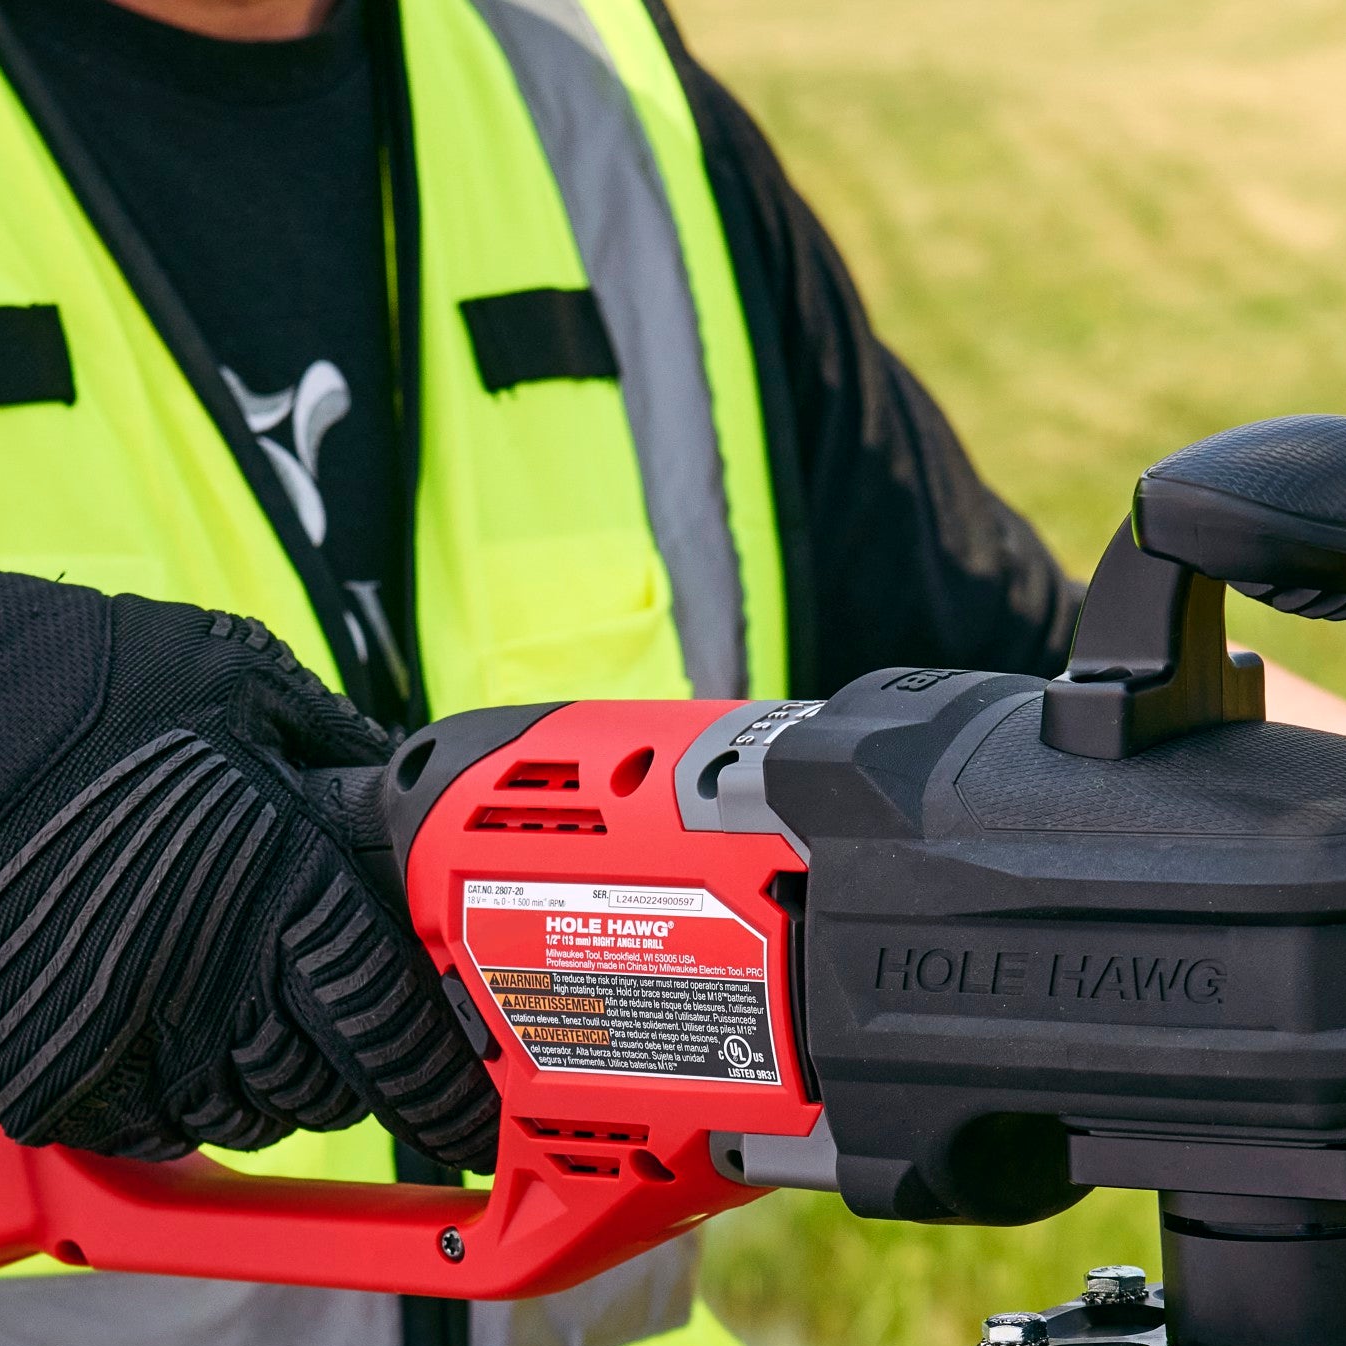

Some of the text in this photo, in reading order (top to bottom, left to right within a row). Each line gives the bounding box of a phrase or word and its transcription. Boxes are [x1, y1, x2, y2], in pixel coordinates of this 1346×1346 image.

[495, 886, 524, 896] 2807-20
[593, 889, 695, 906] SER. L24AD224900597
[545, 916, 602, 934] HOLE
[562, 935, 574, 946] (13
[575, 936, 591, 947] mm)
[593, 937, 615, 948] RIGHT
[617, 938, 641, 949] ANGLE
[642, 939, 664, 950] DRILL
[546, 949, 696, 964] Milwaukee Tool, Brookfield, WI 53005 USA
[546, 958, 763, 977] Professionally made in China by Milwaukee Electric Tool, PRC
[874, 947, 1229, 1004] HOLE HAWG
[499, 973, 550, 989] WARNING
[552, 973, 752, 992] To reduce the risk of injury, user must read operator's manual.
[553, 984, 569, 995] High
[570, 985, 595, 996] rotating
[596, 986, 615, 996] force.
[617, 988, 633, 997] Hold
[641, 989, 661, 998] brace
[661, 990, 692, 1002] securely.
[692, 991, 706, 1001] Use
[514, 995, 602, 1013] AVERTISSEMENT
[605, 997, 618, 1006] Afin
[619, 998, 628, 1007] de
[653, 1000, 660, 1009] le
[661, 1000, 682, 1012] risque
[683, 1001, 692, 1010] de
[693, 1002, 728, 1014] blessures,
[619, 1009, 631, 1017] lire
[631, 1010, 638, 1018] le
[639, 1010, 664, 1019] manual
[665, 1011, 674, 1020] de
[510, 1014, 536, 1023] rotation
[561, 1016, 582, 1026] Tenez
[601, 1019, 610, 1027] ou
[681, 1022, 705, 1032] Utiliser
[706, 1024, 719, 1034] des
[720, 1025, 736, 1035] piles
[534, 1027, 609, 1044] ADVERTENCIA
[609, 1028, 720, 1044] Para reducir el riesgo de lesiones,
[530, 1045, 541, 1054] del
[542, 1046, 574, 1058] operador.
[576, 1046, 589, 1056] Alta
[589, 1047, 611, 1057] fuerza
[612, 1049, 621, 1058] de
[651, 1051, 674, 1062] Sujete
[675, 1052, 681, 1061] la
[611, 1039, 618, 1048] el
[618, 1041, 643, 1050] usuario
[644, 1041, 661, 1051] debe
[662, 1042, 676, 1051] leer
[676, 1043, 683, 1051] el
[538, 1057, 562, 1067] segura
[567, 1056, 607, 1068] firmemente.
[608, 1058, 629, 1068] Utilice
[752, 1052, 765, 1063] US
[727, 1067, 776, 1081] LISTED 9R31
